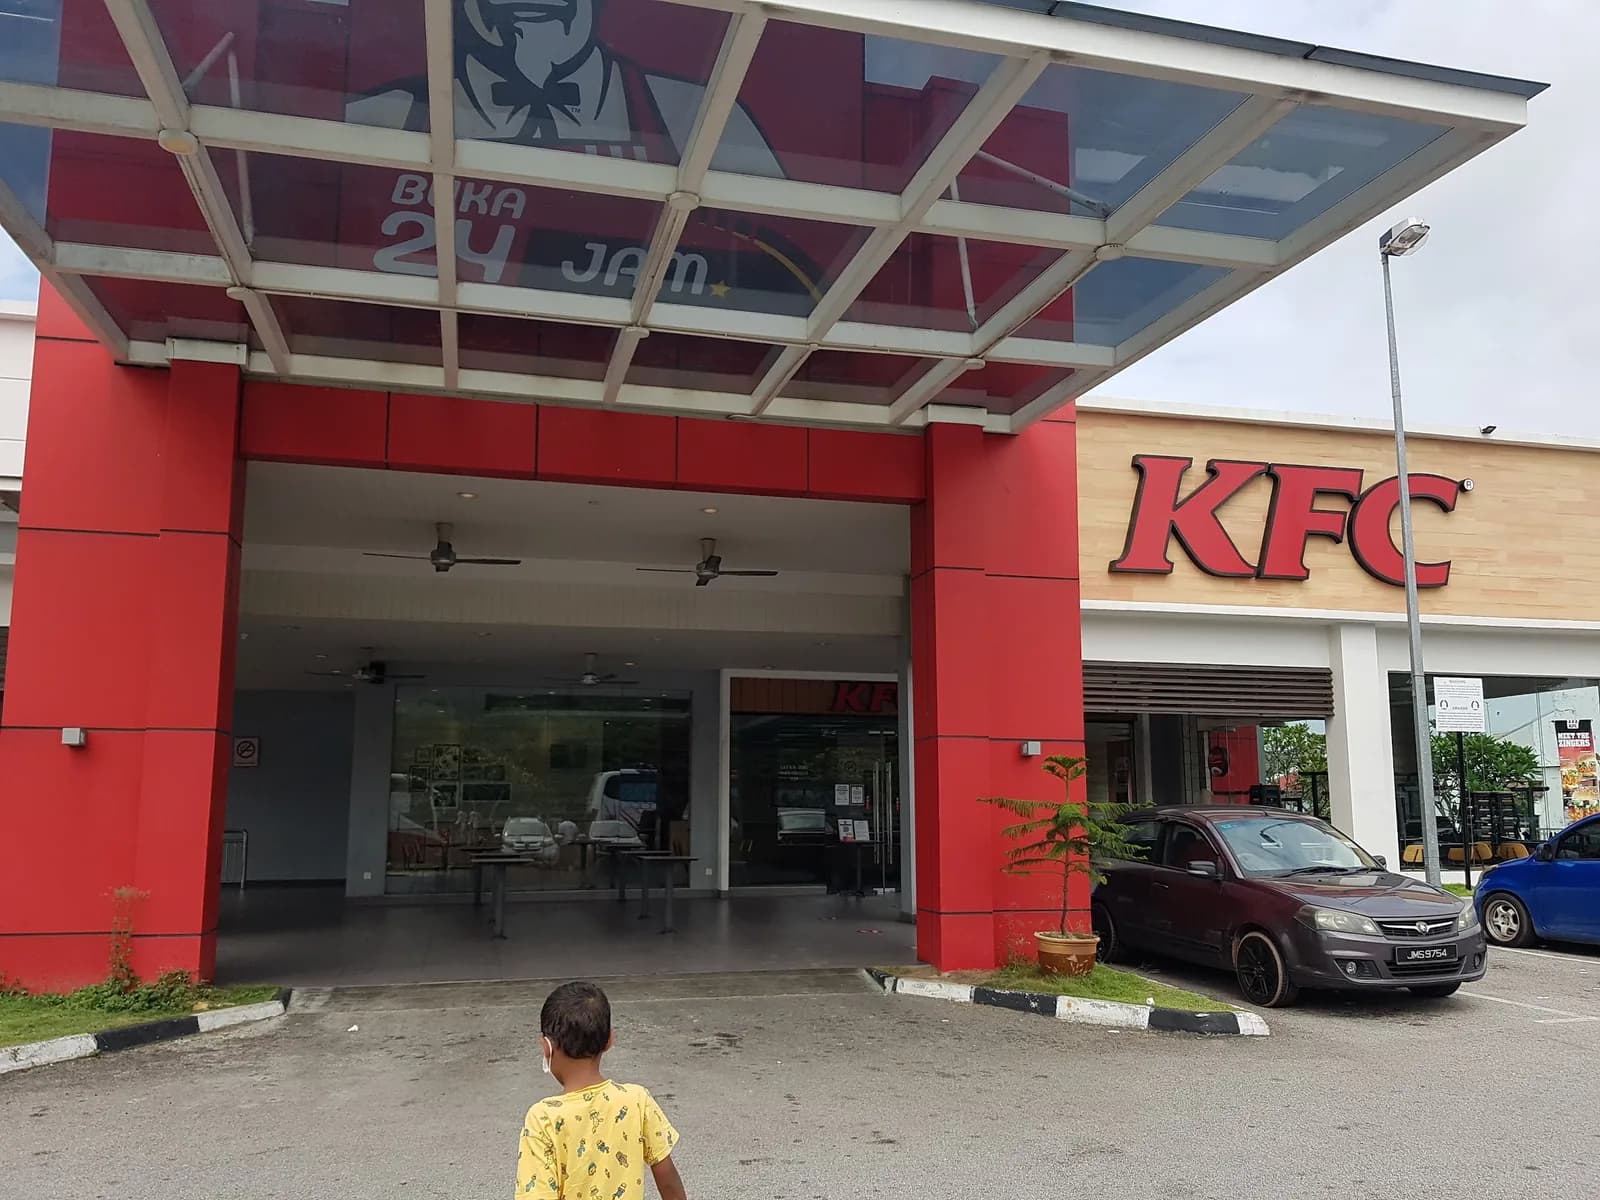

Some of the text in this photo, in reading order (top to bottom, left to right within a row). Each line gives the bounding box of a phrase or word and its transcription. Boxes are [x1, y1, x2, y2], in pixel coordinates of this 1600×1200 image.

[372, 210, 516, 283] 24
[560, 242, 708, 295] JAM
[1107, 454, 1463, 588] KFC
[832, 682, 897, 712] KF
